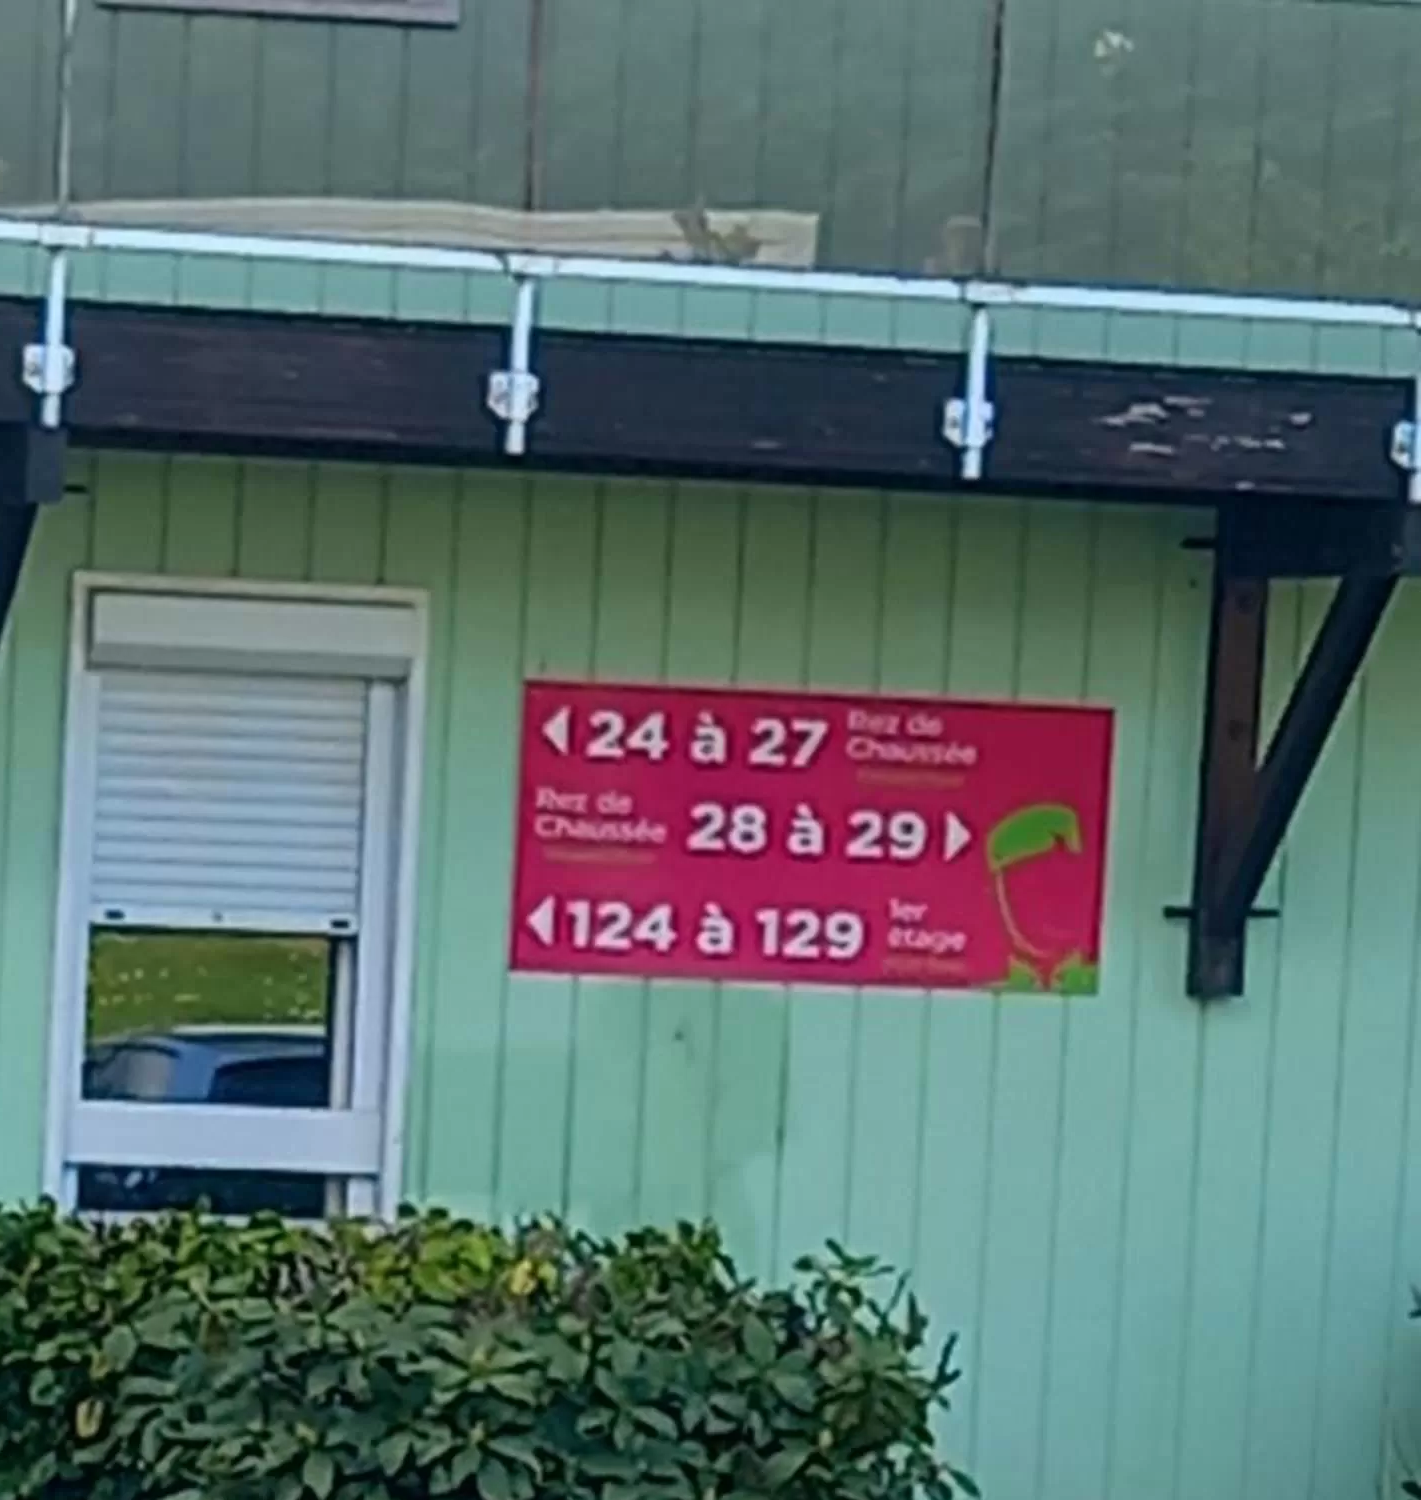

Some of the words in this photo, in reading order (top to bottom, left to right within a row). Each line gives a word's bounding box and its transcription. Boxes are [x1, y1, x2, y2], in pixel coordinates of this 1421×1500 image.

[585, 711, 670, 761] 24
[690, 709, 728, 764] à
[748, 718, 828, 767] 27
[906, 711, 944, 736] de
[596, 789, 633, 815] de
[685, 802, 767, 853] 28
[786, 802, 825, 855] à
[845, 809, 927, 859] 29
[566, 899, 677, 952] 124
[695, 901, 734, 956] à
[755, 908, 865, 960] 129
